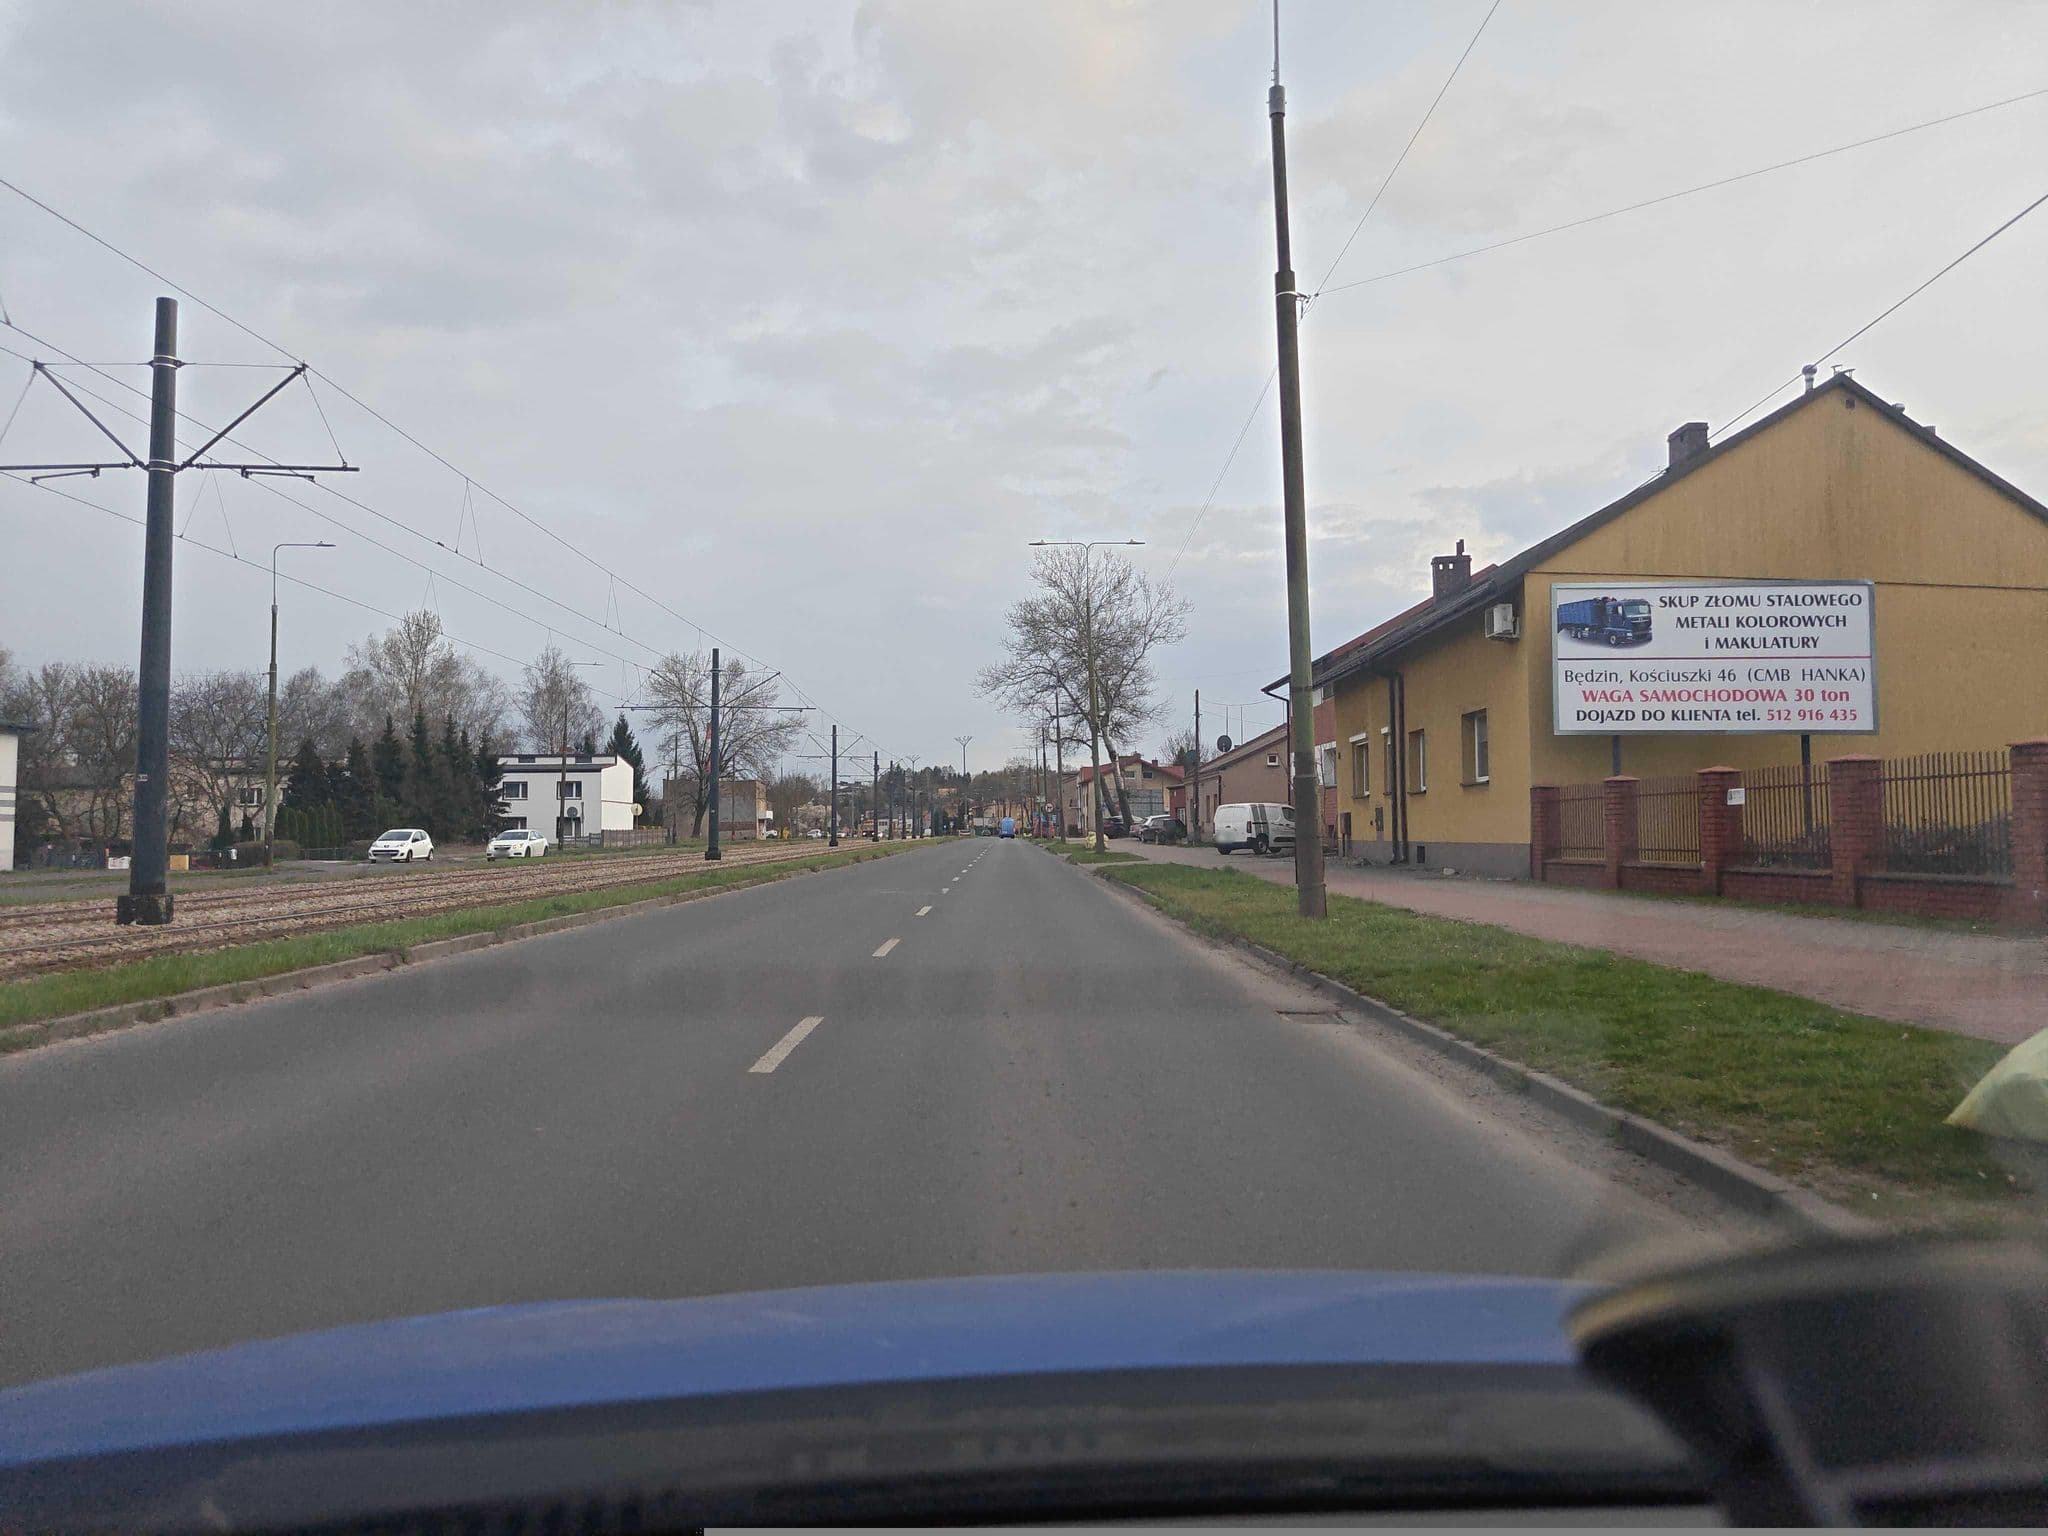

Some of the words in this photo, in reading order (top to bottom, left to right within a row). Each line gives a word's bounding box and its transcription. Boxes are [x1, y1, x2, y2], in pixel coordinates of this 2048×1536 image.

[1658, 595, 1699, 608] SKUP
[1704, 595, 1761, 608] ZŁOMU
[1766, 593, 1862, 607] STALOWEGO
[1675, 616, 1730, 629] METALI
[1736, 615, 1847, 628] KOLOROWYCH
[1704, 637, 1709, 649] i
[1715, 636, 1820, 649] MAKULATURY
[1564, 669, 1623, 685] Będzin,
[1629, 668, 1712, 682] Kościuszki
[1717, 669, 1736, 682] 46
[1747, 667, 1790, 682] (CMB
[1801, 667, 1866, 682] HANKA)
[1582, 690, 1634, 702] WAGA
[1639, 689, 1787, 702] SAMOCHODOWA
[1794, 689, 1814, 702] 30
[1821, 689, 1850, 702] ton
[1576, 710, 1636, 723] DOJAZD
[1641, 709, 1665, 721] DO
[1671, 709, 1731, 721] KLIENTA
[1736, 708, 1761, 721] tel.
[1766, 709, 1792, 721] 512
[1797, 709, 1824, 721] 916
[1829, 709, 1857, 721] 435
